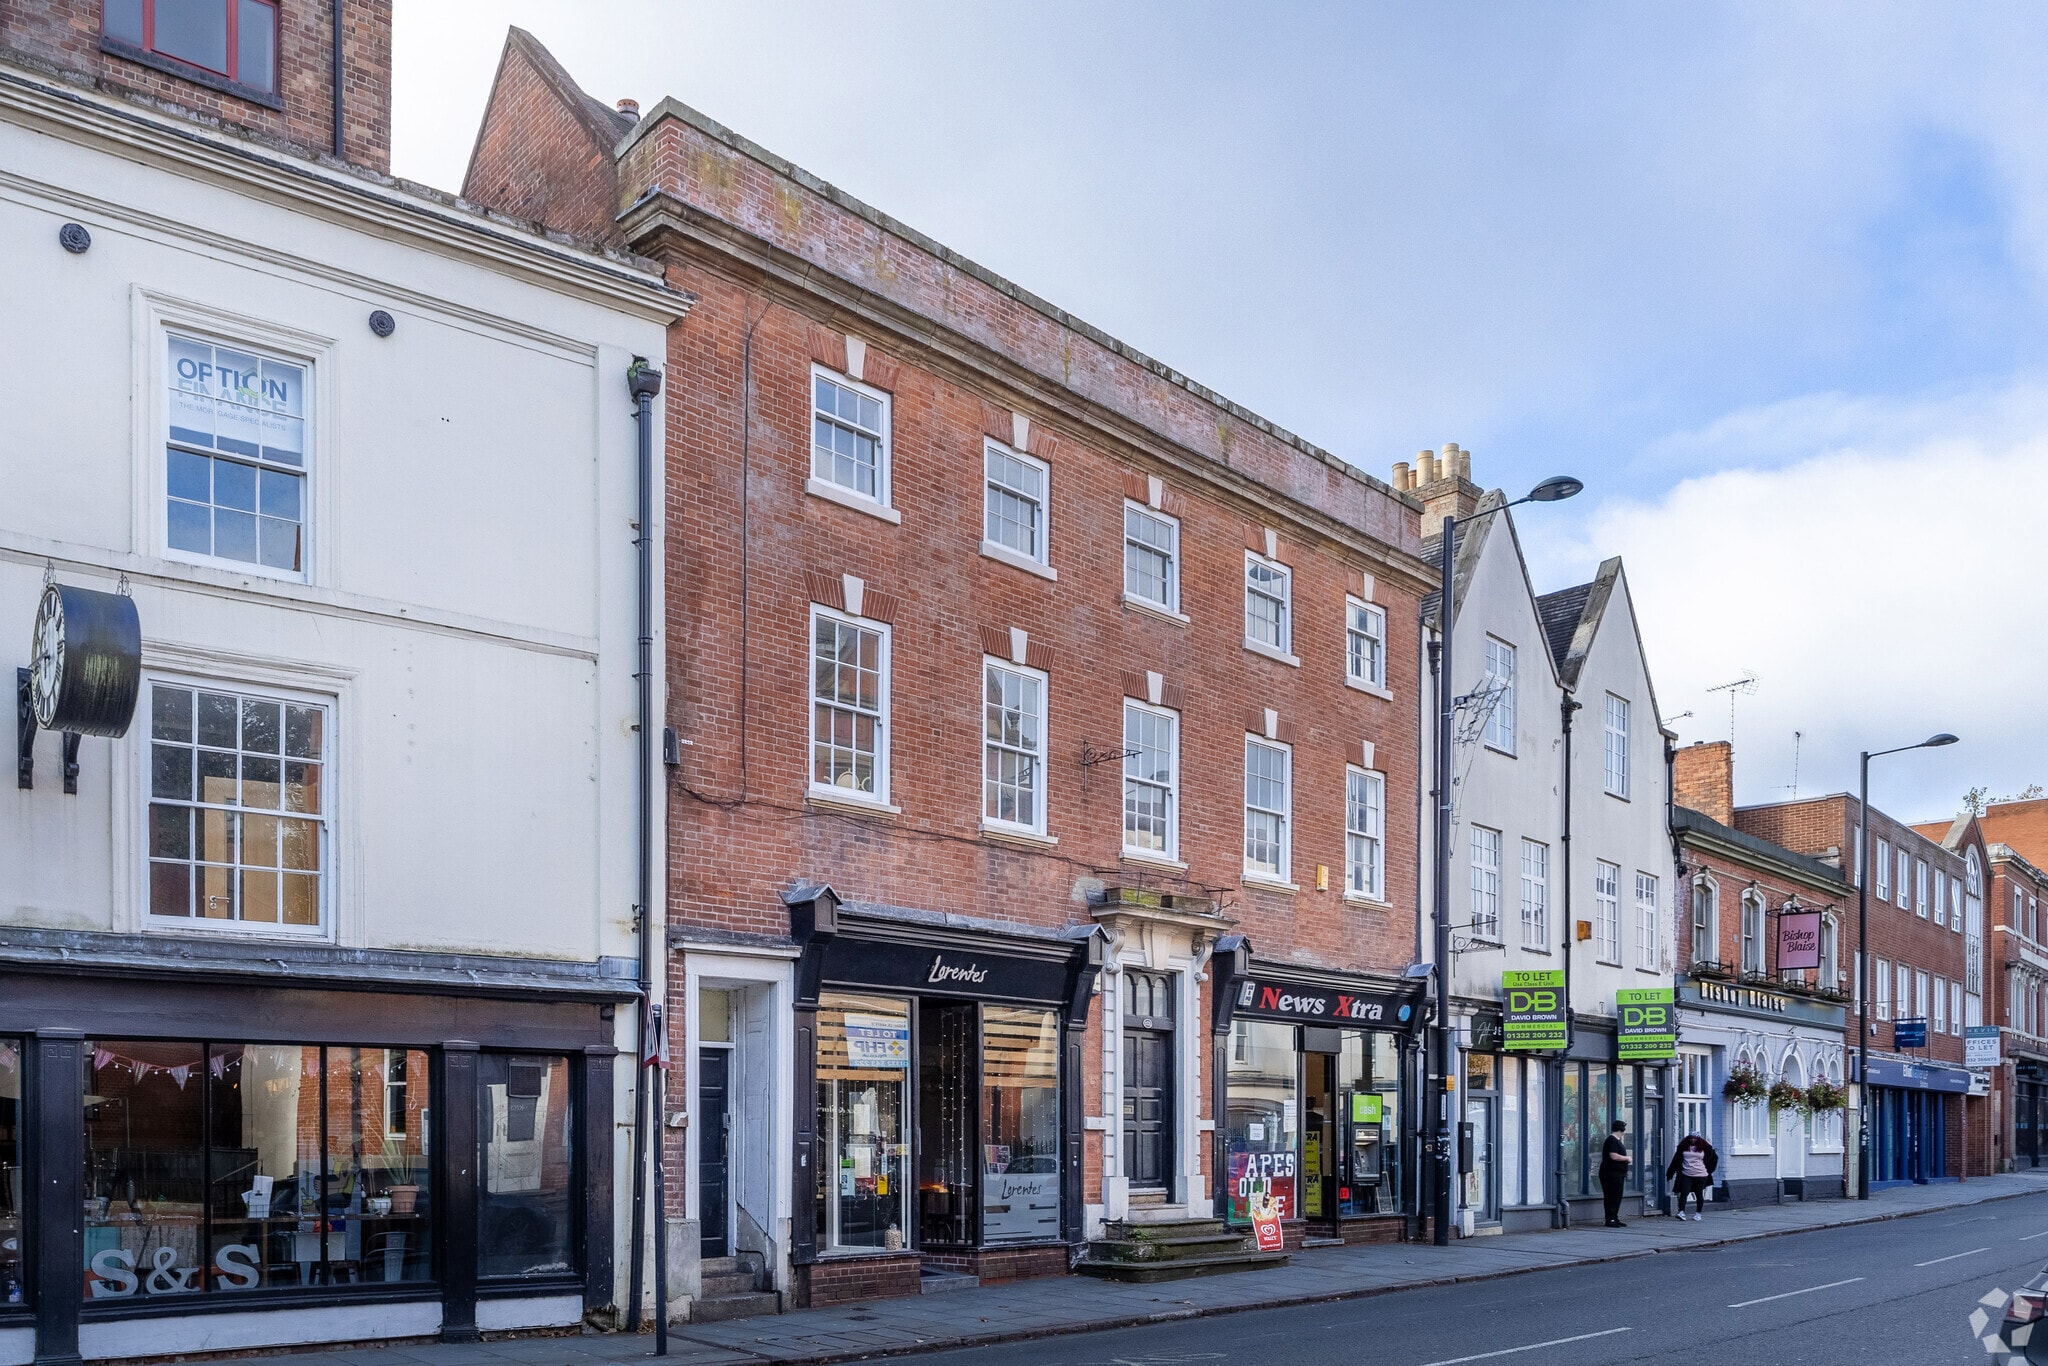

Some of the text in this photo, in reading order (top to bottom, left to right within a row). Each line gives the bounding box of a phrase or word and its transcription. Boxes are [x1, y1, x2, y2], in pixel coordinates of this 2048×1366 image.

[177, 358, 287, 402] OPTION
[179, 402, 286, 432] THE MORGAGE SPECALISTS
[1782, 930, 1814, 941] Bishop
[1786, 941, 1816, 952] Blaise
[928, 955, 988, 982] Lorentes
[1515, 972, 1552, 981] TO LET
[1259, 987, 1325, 1015] News
[1333, 995, 1383, 1020] Xtra
[1629, 992, 1662, 1001] TO LET
[1359, 1103, 1377, 1115] cash
[1001, 1179, 1042, 1200] Lorentes
